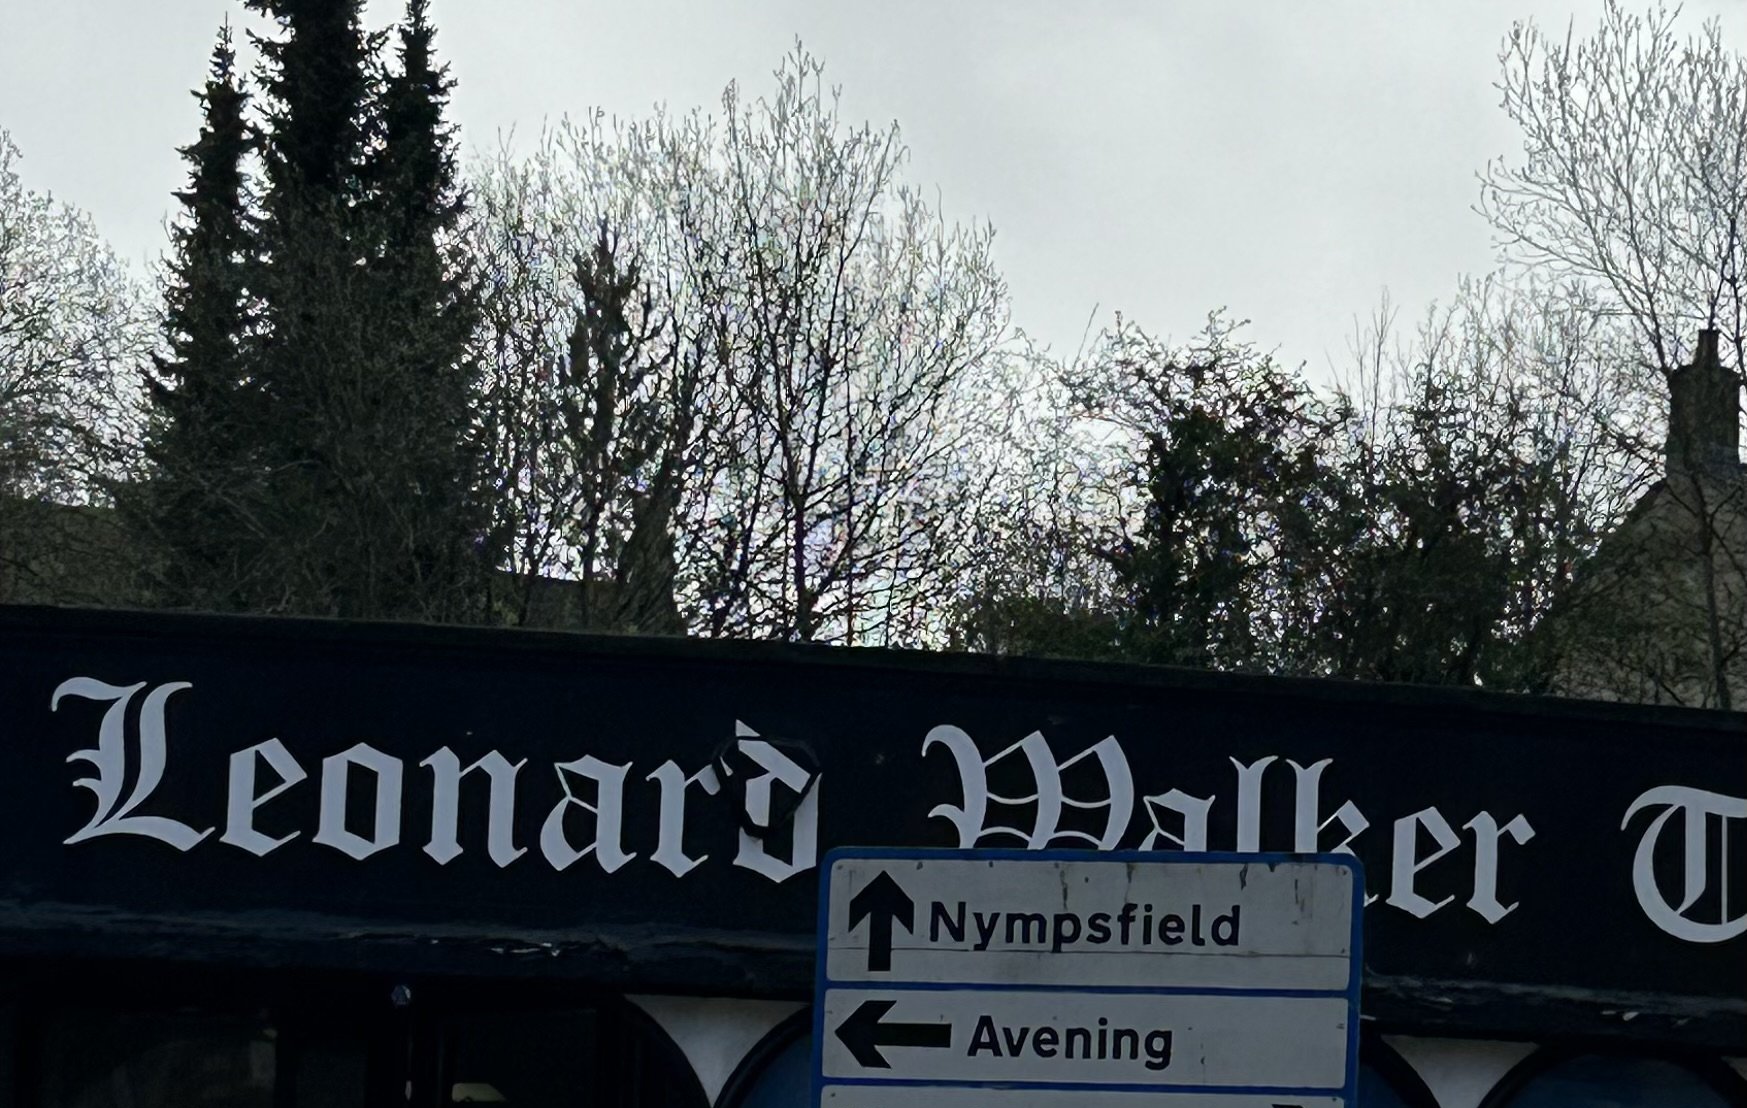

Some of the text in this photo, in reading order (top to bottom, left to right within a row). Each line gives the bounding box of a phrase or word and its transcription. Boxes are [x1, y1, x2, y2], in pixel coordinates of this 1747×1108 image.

[51, 677, 821, 884] Leonard
[922, 724, 1536, 925] Walker
[929, 901, 1241, 954] Nympsfield
[967, 1015, 1173, 1071] Avening
